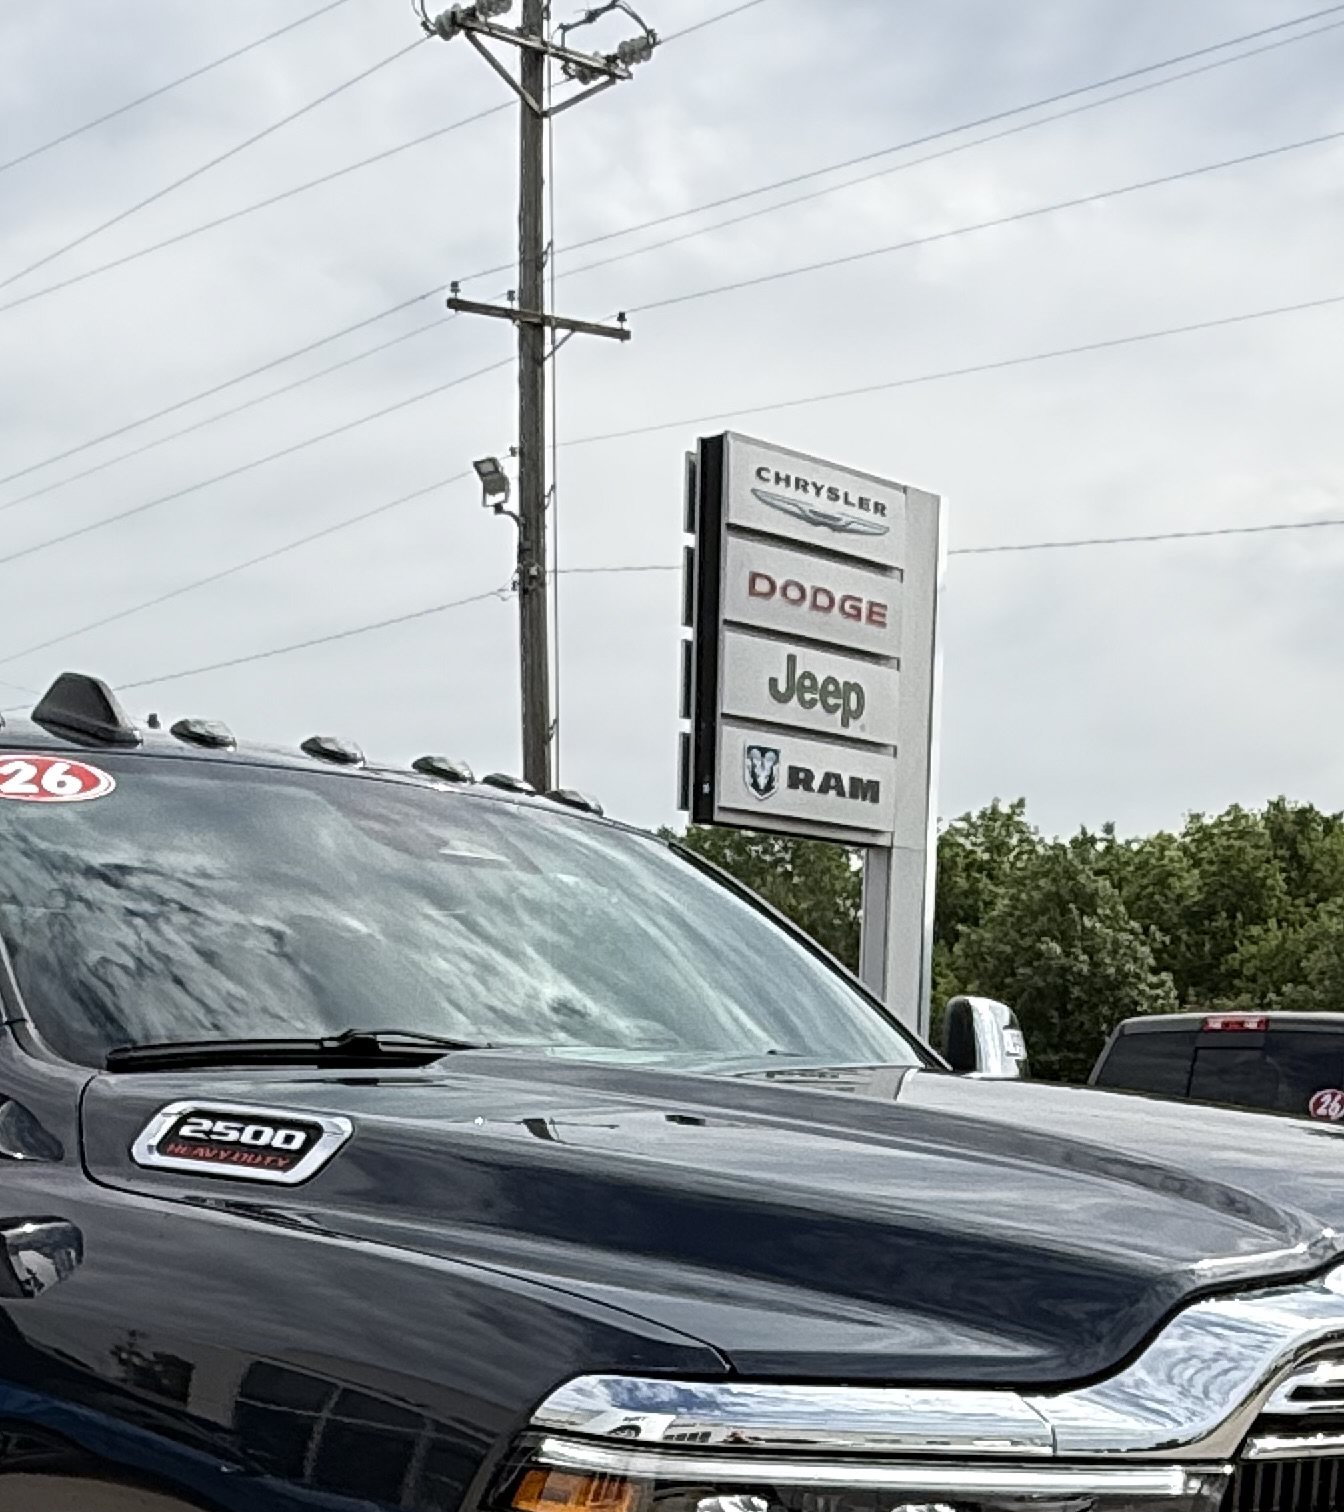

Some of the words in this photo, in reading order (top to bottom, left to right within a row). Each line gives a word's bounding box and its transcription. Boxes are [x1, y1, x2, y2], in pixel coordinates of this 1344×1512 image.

[756, 466, 887, 518] CHRYSLER
[748, 571, 887, 628] DODGE
[769, 654, 865, 727] Jeep
[787, 765, 880, 803] RAM
[1317, 1094, 1342, 1117] 26
[178, 1118, 307, 1150] 2500
